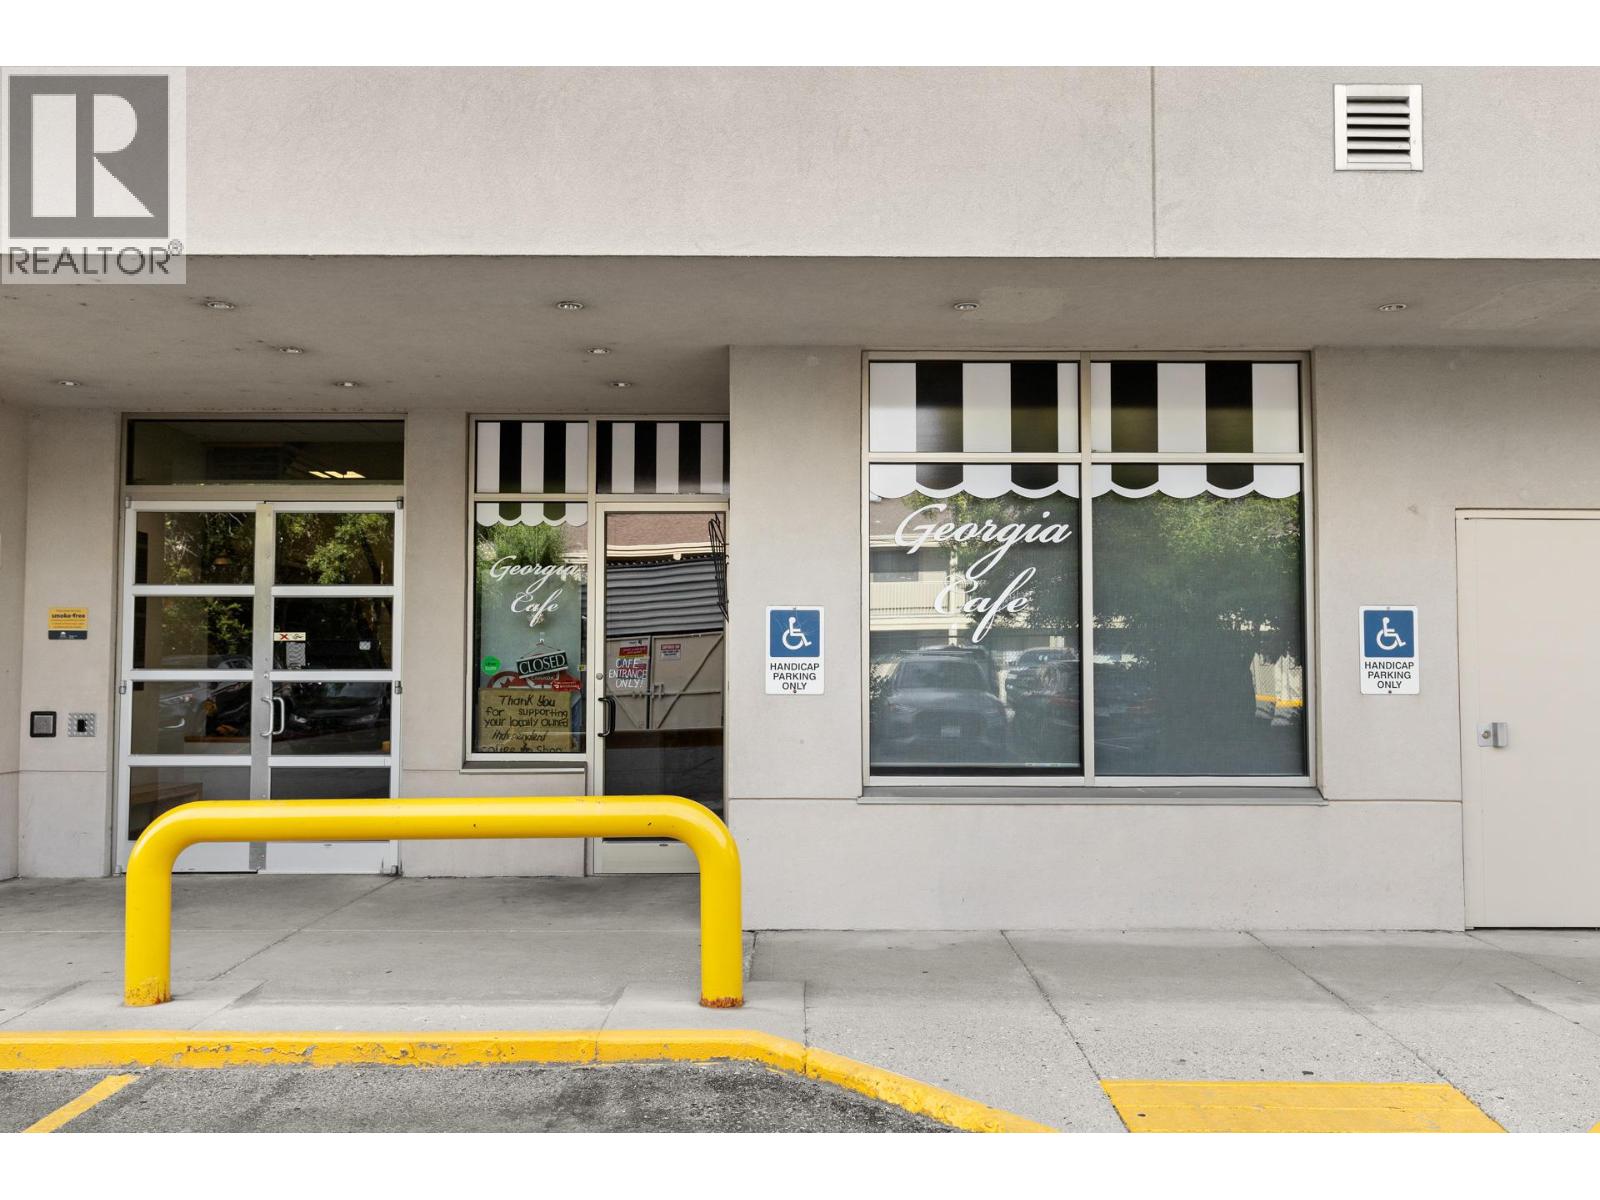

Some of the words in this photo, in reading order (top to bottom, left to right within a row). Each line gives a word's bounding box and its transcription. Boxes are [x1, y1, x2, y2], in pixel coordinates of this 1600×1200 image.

[895, 503, 1072, 580] Georgia
[490, 555, 579, 595] Georgia
[511, 588, 563, 628] Cafe
[934, 567, 1036, 644] Cafe
[519, 654, 566, 674] CLOSED
[615, 658, 640, 669] CAFE
[770, 663, 820, 671] HANDICAP
[1364, 661, 1414, 669] HANDICAP
[608, 669, 648, 679] ENTRANCE
[773, 672, 816, 681] PARKING
[1368, 671, 1411, 680] PARKING
[782, 682, 807, 690] ONLY
[1377, 681, 1402, 689] ONLY
[485, 706, 504, 717] for
[518, 708, 568, 719] supporting
[484, 718, 506, 728] your
